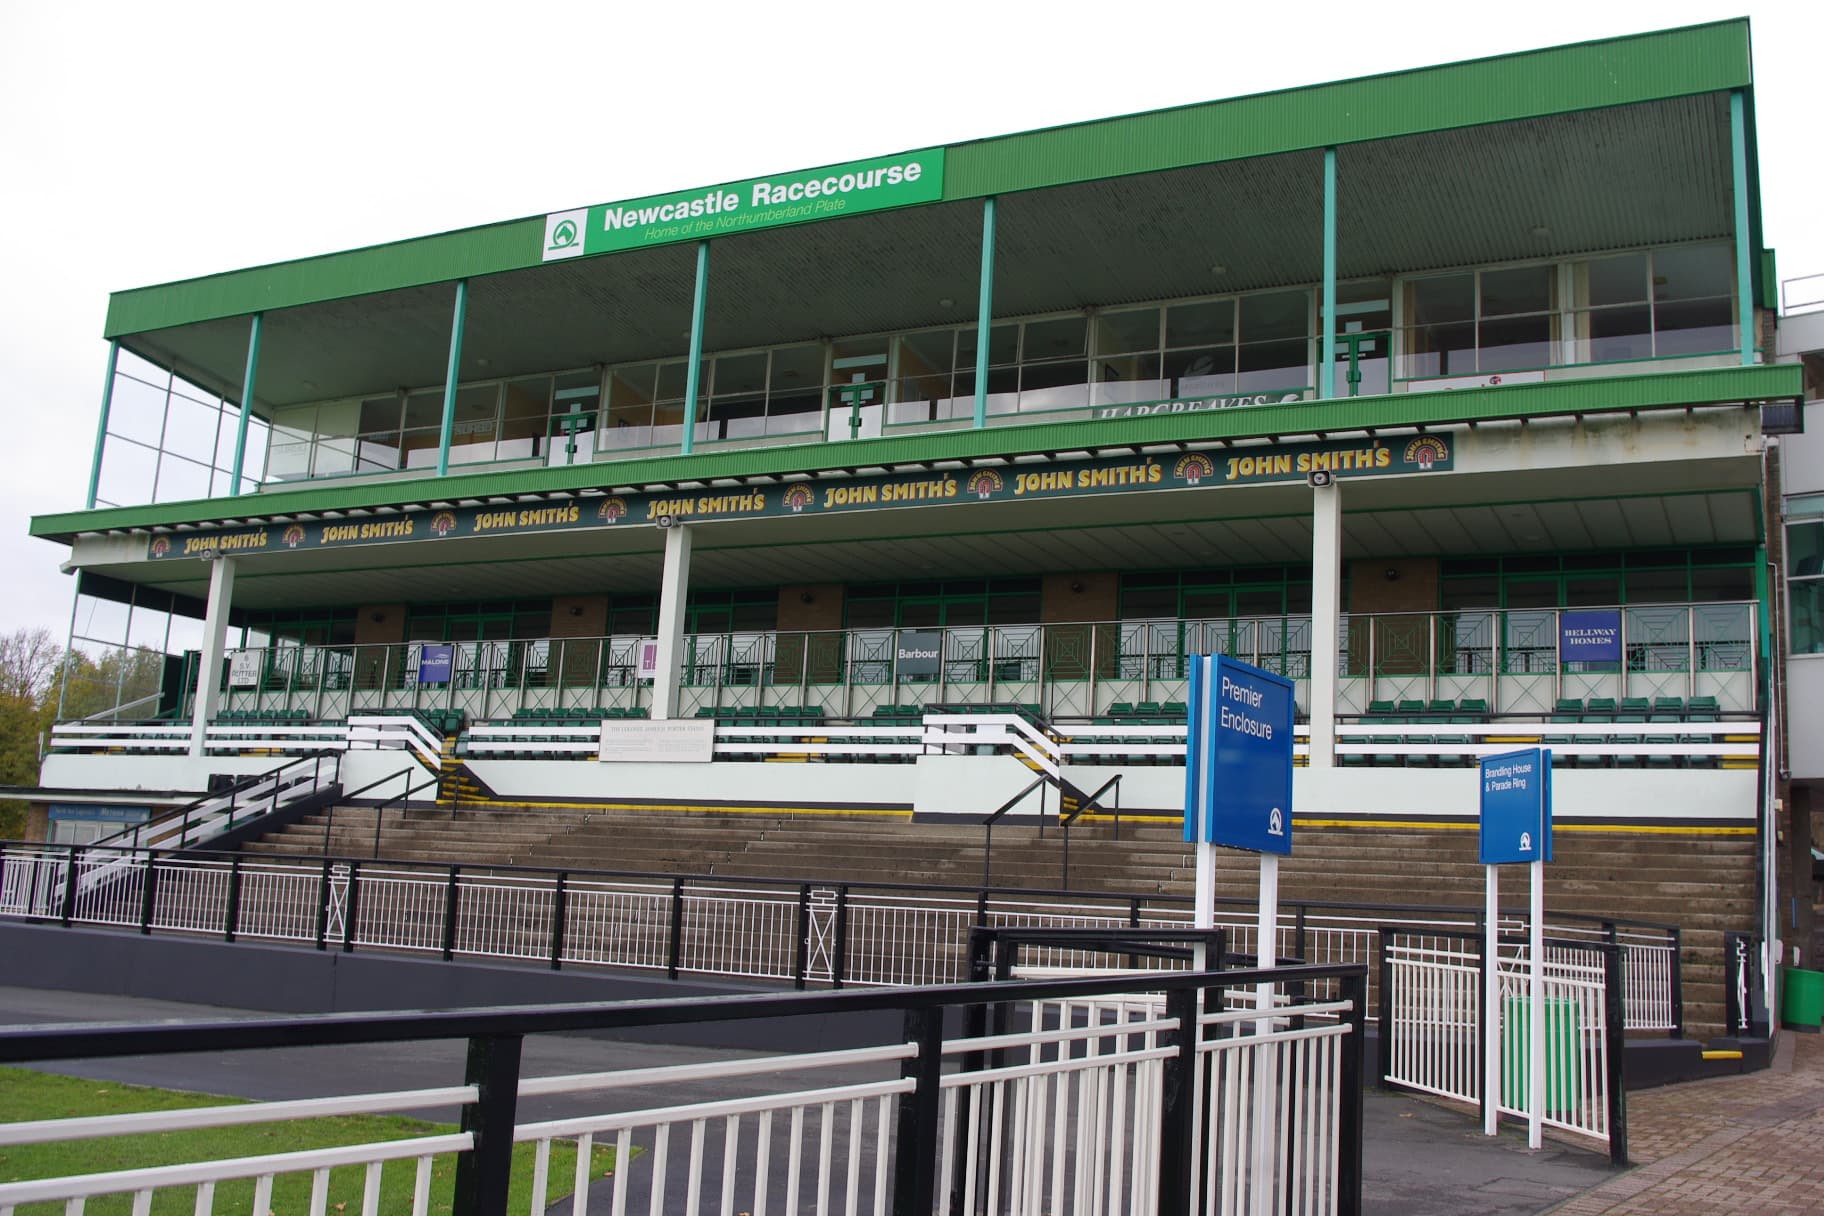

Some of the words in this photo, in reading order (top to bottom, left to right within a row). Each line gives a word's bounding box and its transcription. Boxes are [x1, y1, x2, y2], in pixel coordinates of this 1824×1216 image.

[604, 190, 740, 231] Newcastle
[751, 162, 922, 207] Racecourse
[644, 227, 679, 240] Home
[680, 222, 694, 235] of
[696, 218, 713, 232] the
[715, 202, 813, 228] Northumberland
[815, 199, 846, 214] Plate
[1013, 470, 1074, 495] JOHN
[1078, 456, 1163, 488] SMITH'S
[1225, 454, 1292, 480] JOHN
[1296, 439, 1392, 472] SMITH'S
[646, 498, 695, 520] JOHN
[698, 488, 765, 513] SMITH'S
[823, 485, 878, 508] JOHN
[881, 472, 958, 501] SMITH'S
[320, 525, 358, 544] JOHN
[361, 514, 414, 538] SMITH'S
[473, 511, 516, 532] JOHN
[519, 500, 580, 526] SMITH'S
[184, 536, 218, 554] JOHN
[220, 528, 268, 549] SMITH'S
[1564, 628, 1616, 637] BELLWAY
[1570, 637, 1612, 645] HOMES
[898, 648, 939, 659] Barbour
[1222, 675, 1263, 709] Premier
[1221, 705, 1272, 740] Enclosure
[1485, 766, 1512, 778] Brandling
[1512, 762, 1532, 774] House
[1485, 782, 1490, 792] &
[1491, 780, 1512, 791] Parade
[1512, 777, 1526, 789] Ring
